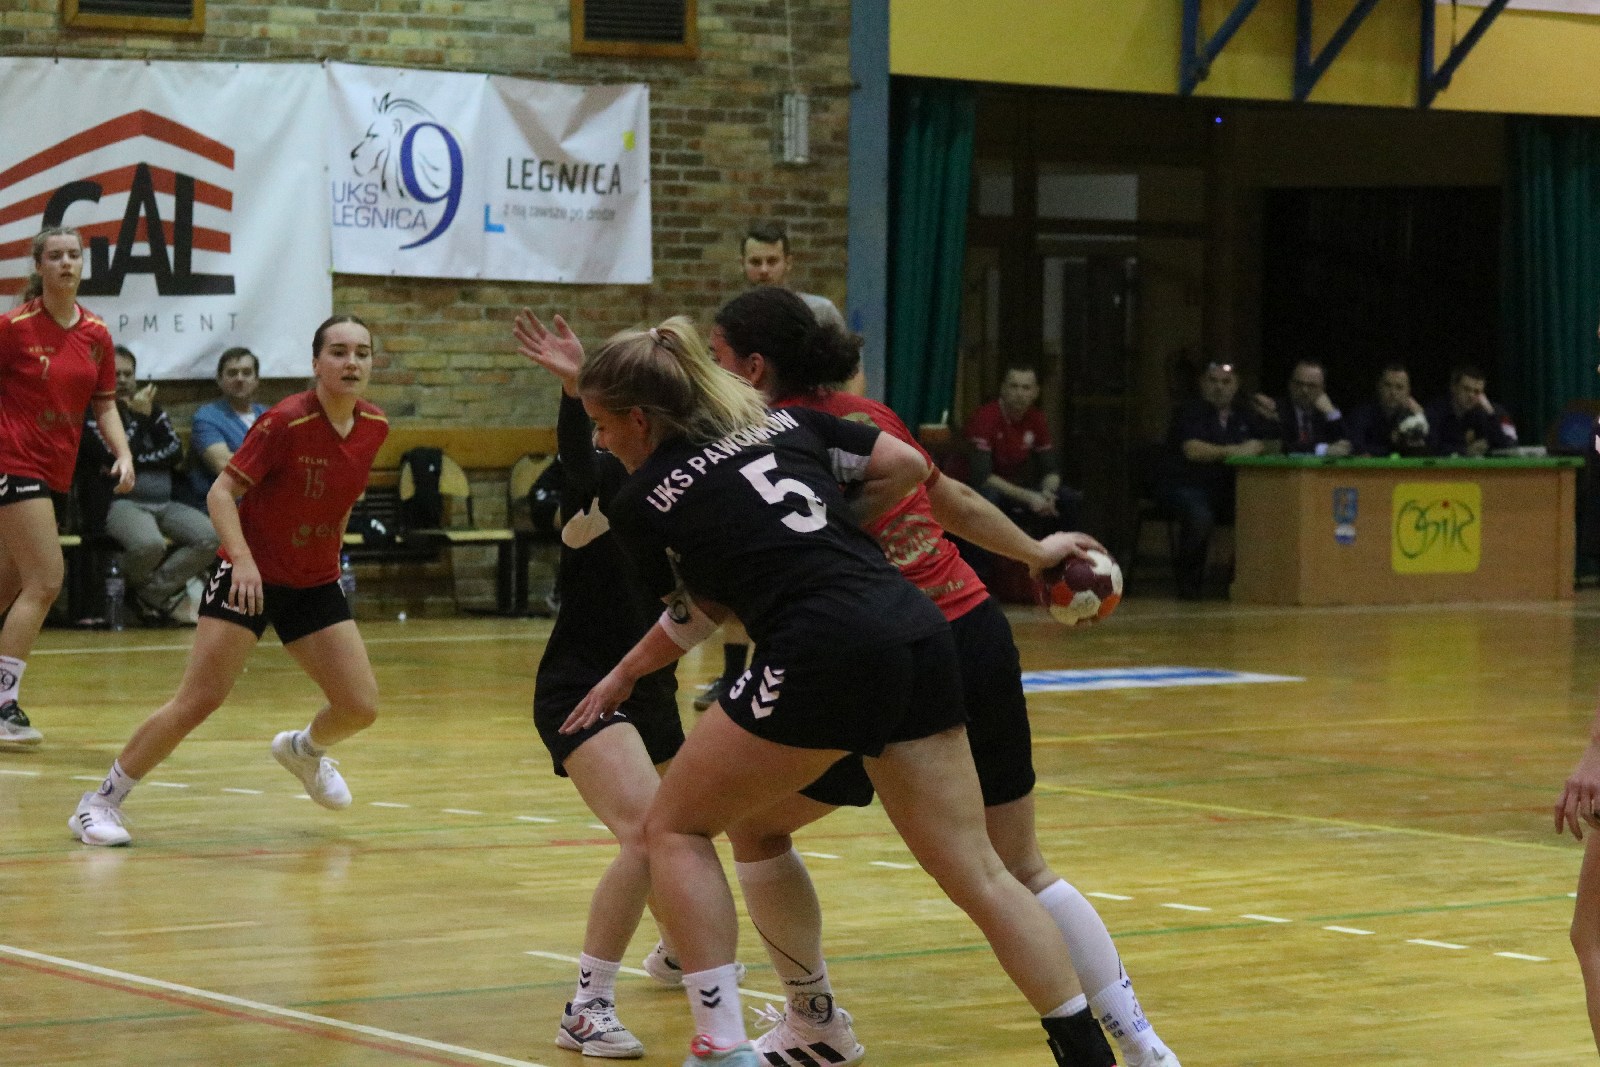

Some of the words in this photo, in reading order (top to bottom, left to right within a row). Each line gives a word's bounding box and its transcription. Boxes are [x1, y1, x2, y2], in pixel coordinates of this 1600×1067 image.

[332, 180, 379, 203] UKS
[399, 122, 464, 250] 9
[506, 157, 622, 195] LEGNICA
[42, 162, 236, 296] GAL
[332, 204, 428, 230] LEGNICA
[119, 313, 239, 332] PMENT
[304, 468, 325, 499] 15
[646, 468, 694, 513] UKS
[739, 452, 828, 533] 5
[728, 669, 752, 700] 5
